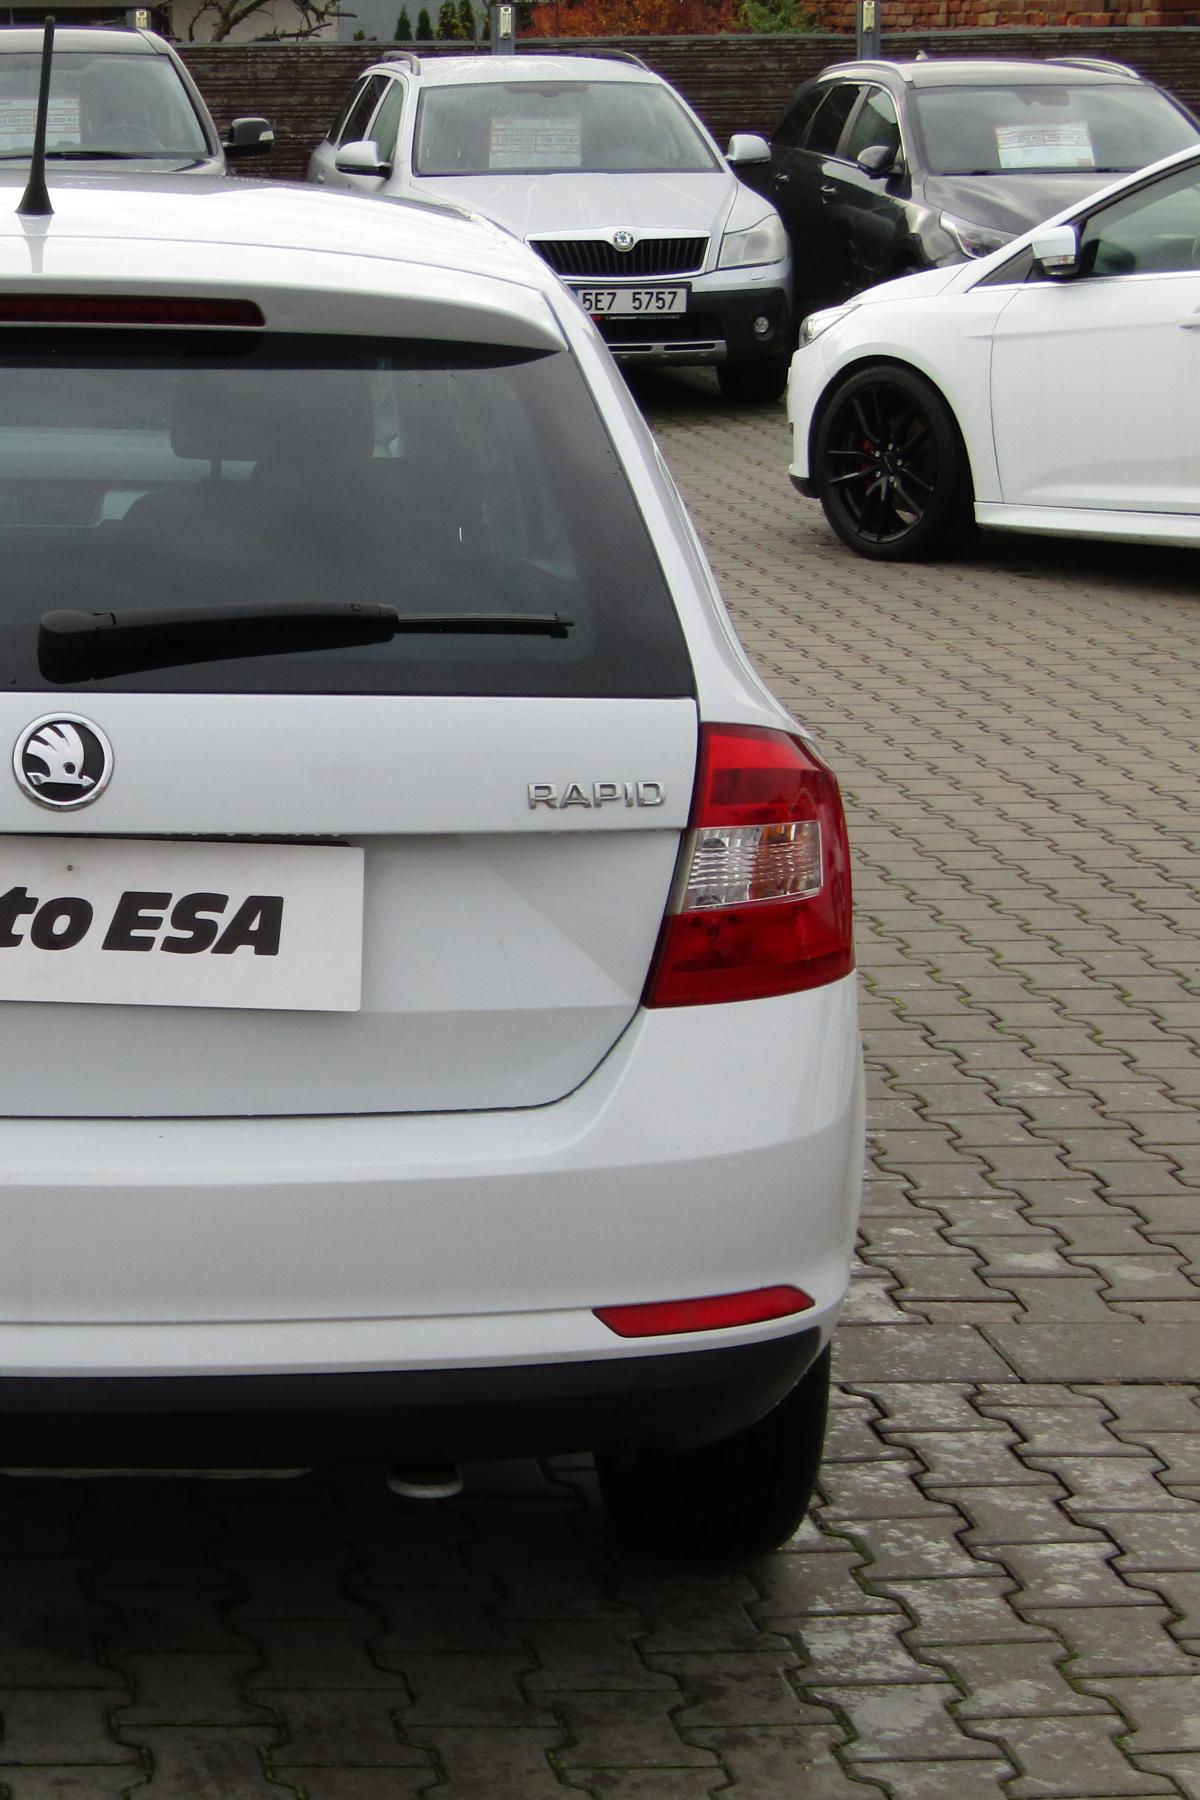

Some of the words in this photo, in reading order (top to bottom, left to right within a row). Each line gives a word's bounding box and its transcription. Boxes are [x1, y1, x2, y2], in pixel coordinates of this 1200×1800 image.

[582, 291, 617, 311] 5E7
[631, 291, 678, 310] 5757
[525, 780, 668, 811] RAPID
[101, 890, 286, 957] ESA
